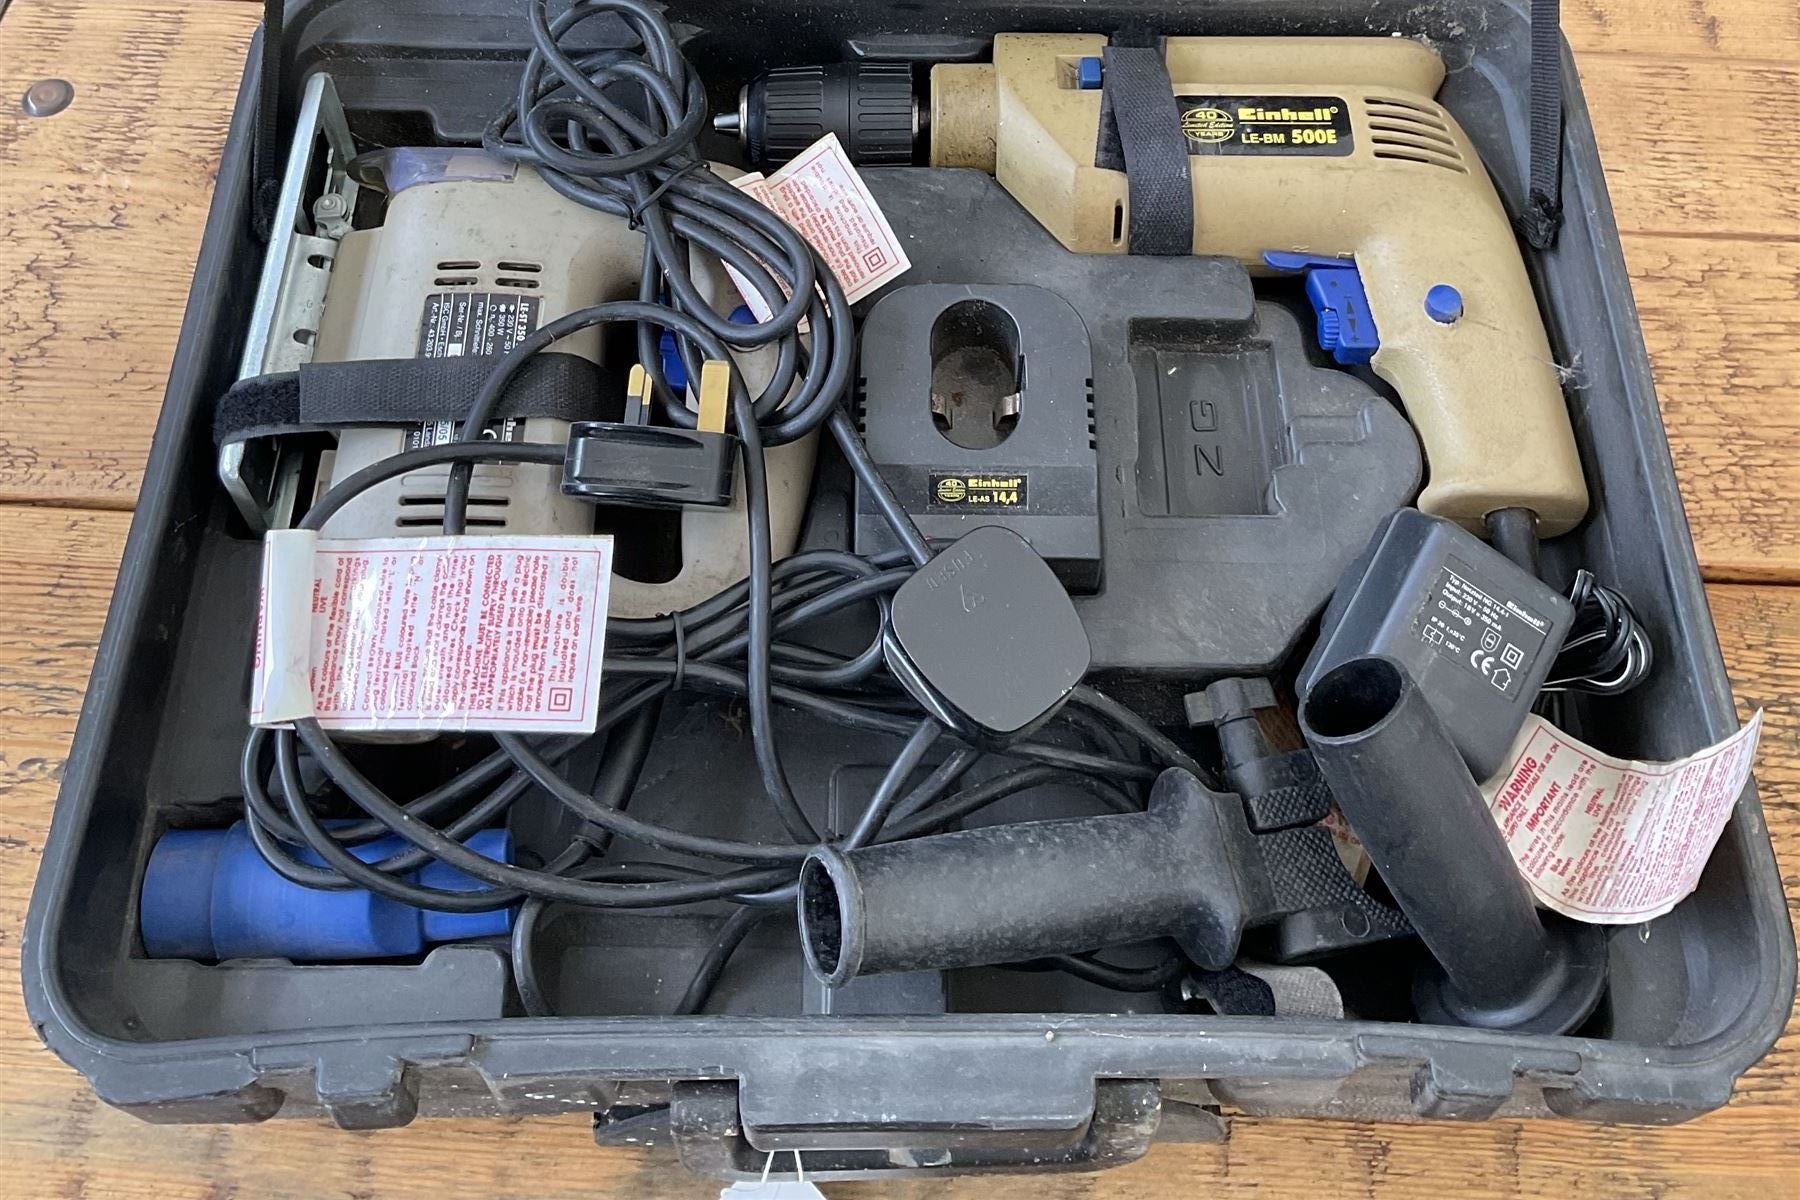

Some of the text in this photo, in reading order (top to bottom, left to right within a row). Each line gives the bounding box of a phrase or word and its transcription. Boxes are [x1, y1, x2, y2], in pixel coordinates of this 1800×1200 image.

[1195, 111, 1217, 119] 40
[1238, 108, 1333, 121] Einhell
[1241, 129, 1337, 145] LE-BM 500E
[439, 315, 448, 336] GmbH
[516, 302, 529, 341] LE-ST 350
[968, 477, 1017, 488] Einhell
[992, 491, 1017, 504] 14,4
[532, 555, 540, 573] note
[559, 556, 569, 589] double
[569, 557, 577, 571] not
[482, 554, 494, 605] CONNECTED
[528, 575, 538, 602] please
[536, 563, 547, 608] discarded
[566, 579, 575, 602] does
[1444, 582, 1461, 596] Input:
[480, 609, 487, 619] BE
[495, 603, 504, 627] FUSED
[501, 639, 513, 684] appliance
[507, 606, 515, 627] fitted
[514, 555, 523, 573] plug
[534, 612, 541, 623] be
[563, 611, 571, 629] and
[1441, 588, 1463, 606] Output:
[1491, 621, 1502, 631] mA
[477, 554, 502, 709] TO THE ELECTRICITY SUPPLY THROUGH
[477, 623, 485, 644] MUST
[506, 680, 515, 710] which
[511, 630, 521, 670] moulded
[516, 606, 524, 626] onto
[521, 555, 530, 586] electric
[551, 613, 562, 655] machine
[572, 614, 580, 636] earth
[570, 638, 577, 649] an
[471, 648, 482, 689] MACHINE
[487, 630, 500, 694] APPROPRIATELY
[529, 653, 538, 673] plug
[538, 651, 546, 670] from
[548, 665, 557, 681] This
[567, 653, 576, 682] require
[485, 696, 492, 709] AN
[515, 686, 524, 711] cable
[534, 673, 543, 711] removed
[1497, 755, 1538, 811] WARNING
[1525, 781, 1560, 831] IMPORTANT
[1527, 834, 1541, 852] wires
[1543, 813, 1554, 826] this
[1552, 791, 1568, 813] mains
[1565, 773, 1580, 791] lead
[1576, 759, 1588, 773] are
[1583, 785, 1604, 814] NEUTRAL
[1525, 842, 1547, 872] coloured
[1550, 792, 1579, 834] accordance
[1576, 775, 1588, 791] with
[1585, 763, 1596, 775] the
[1558, 801, 1603, 877] Brown LIVE
[1532, 849, 1554, 879] following
